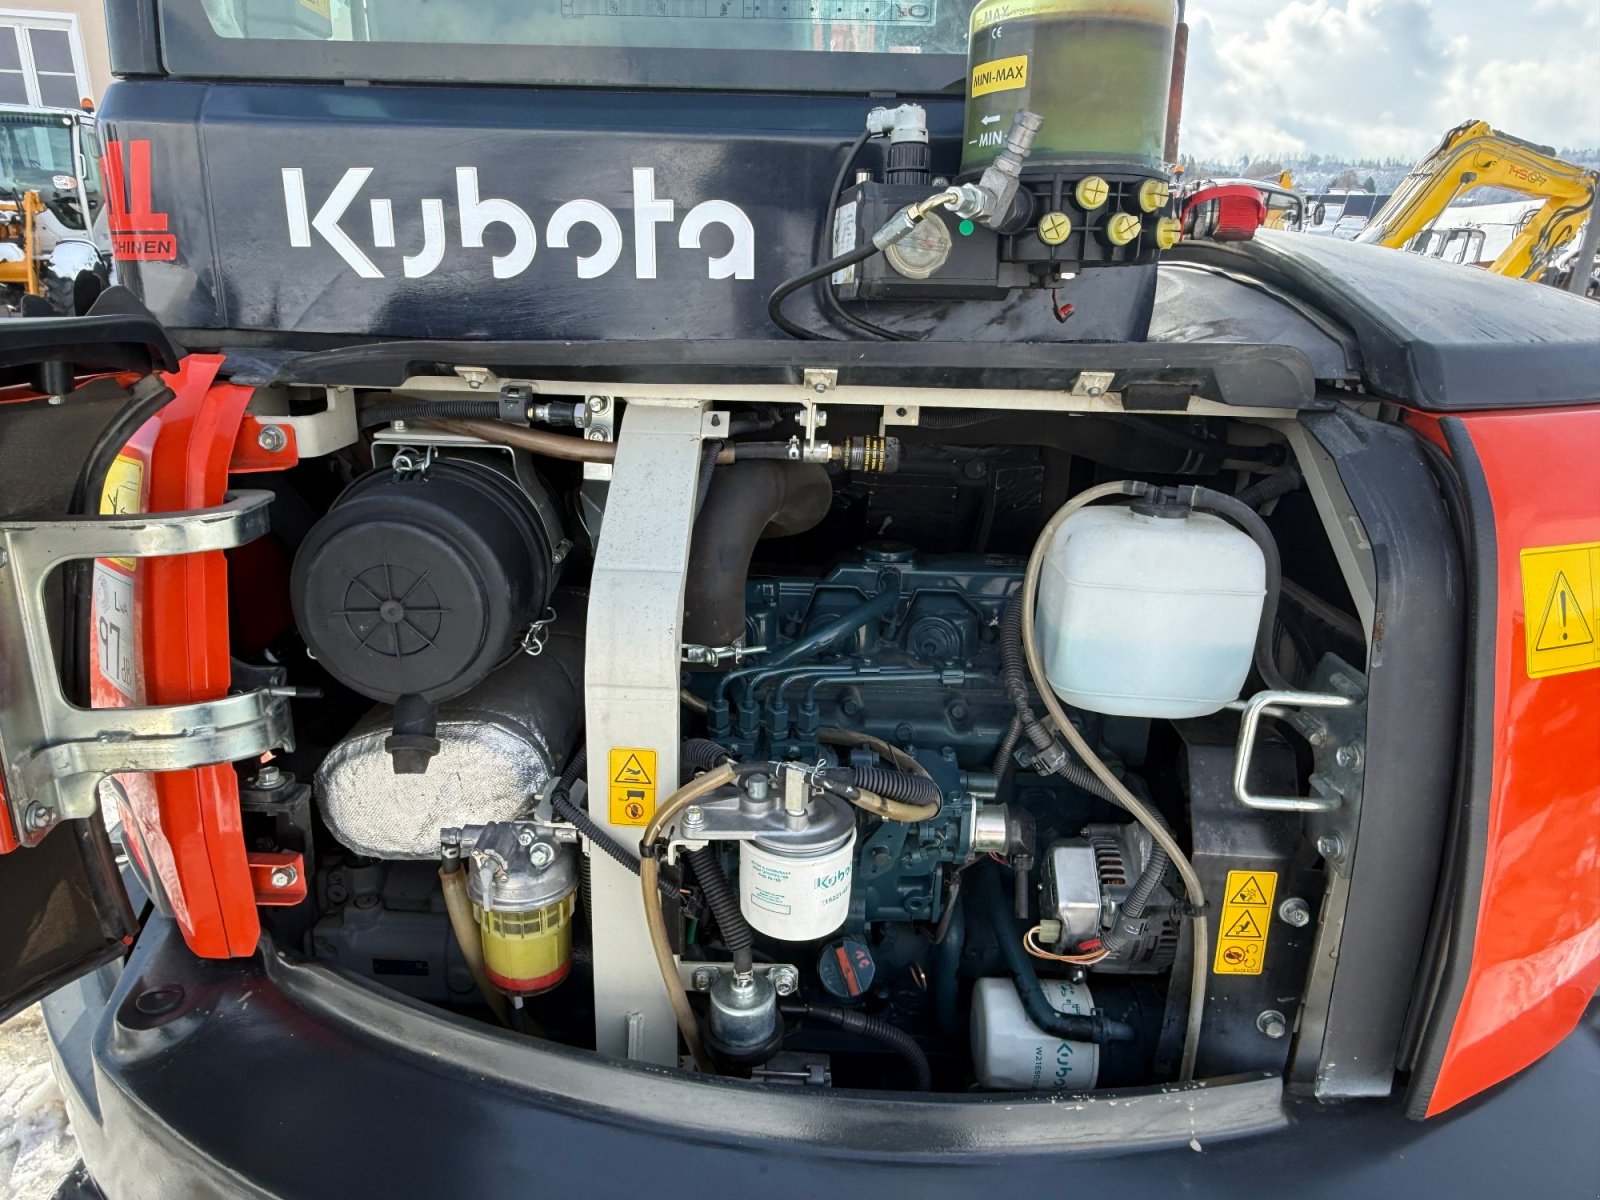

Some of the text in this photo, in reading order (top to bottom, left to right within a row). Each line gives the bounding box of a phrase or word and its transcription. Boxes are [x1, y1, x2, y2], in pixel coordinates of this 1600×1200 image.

[973, 65, 1024, 88] MINI-MAX
[979, 130, 1003, 147] MIN
[281, 166, 755, 280] Kubota
[99, 616, 120, 680] 97
